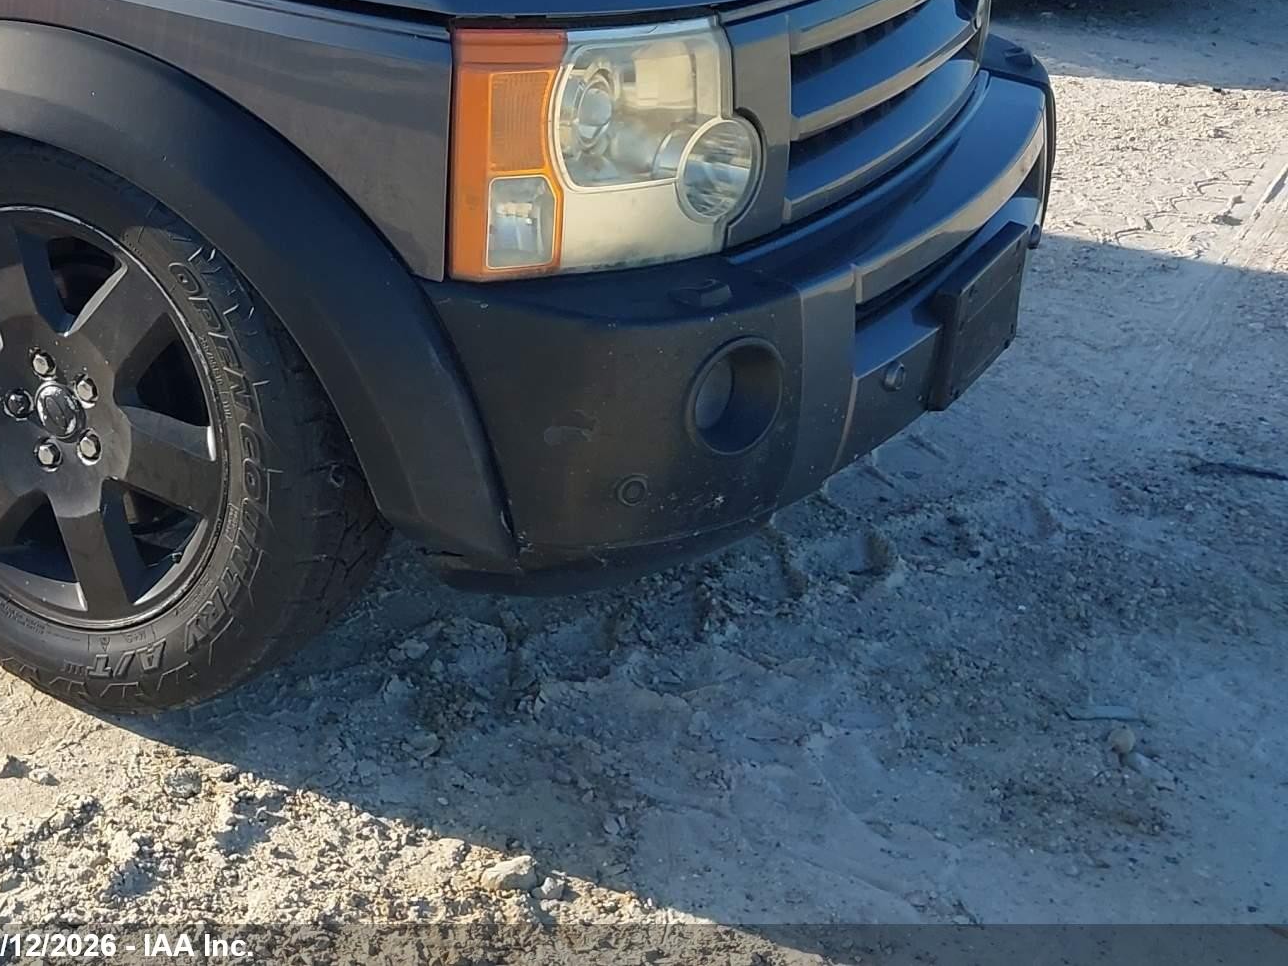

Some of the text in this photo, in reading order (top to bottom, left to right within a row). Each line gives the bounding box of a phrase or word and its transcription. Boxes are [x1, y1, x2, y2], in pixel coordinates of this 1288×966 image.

[168, 262, 253, 411] OPEN
[184, 423, 262, 653] COUNTRY
[86, 637, 167, 679] A/T
